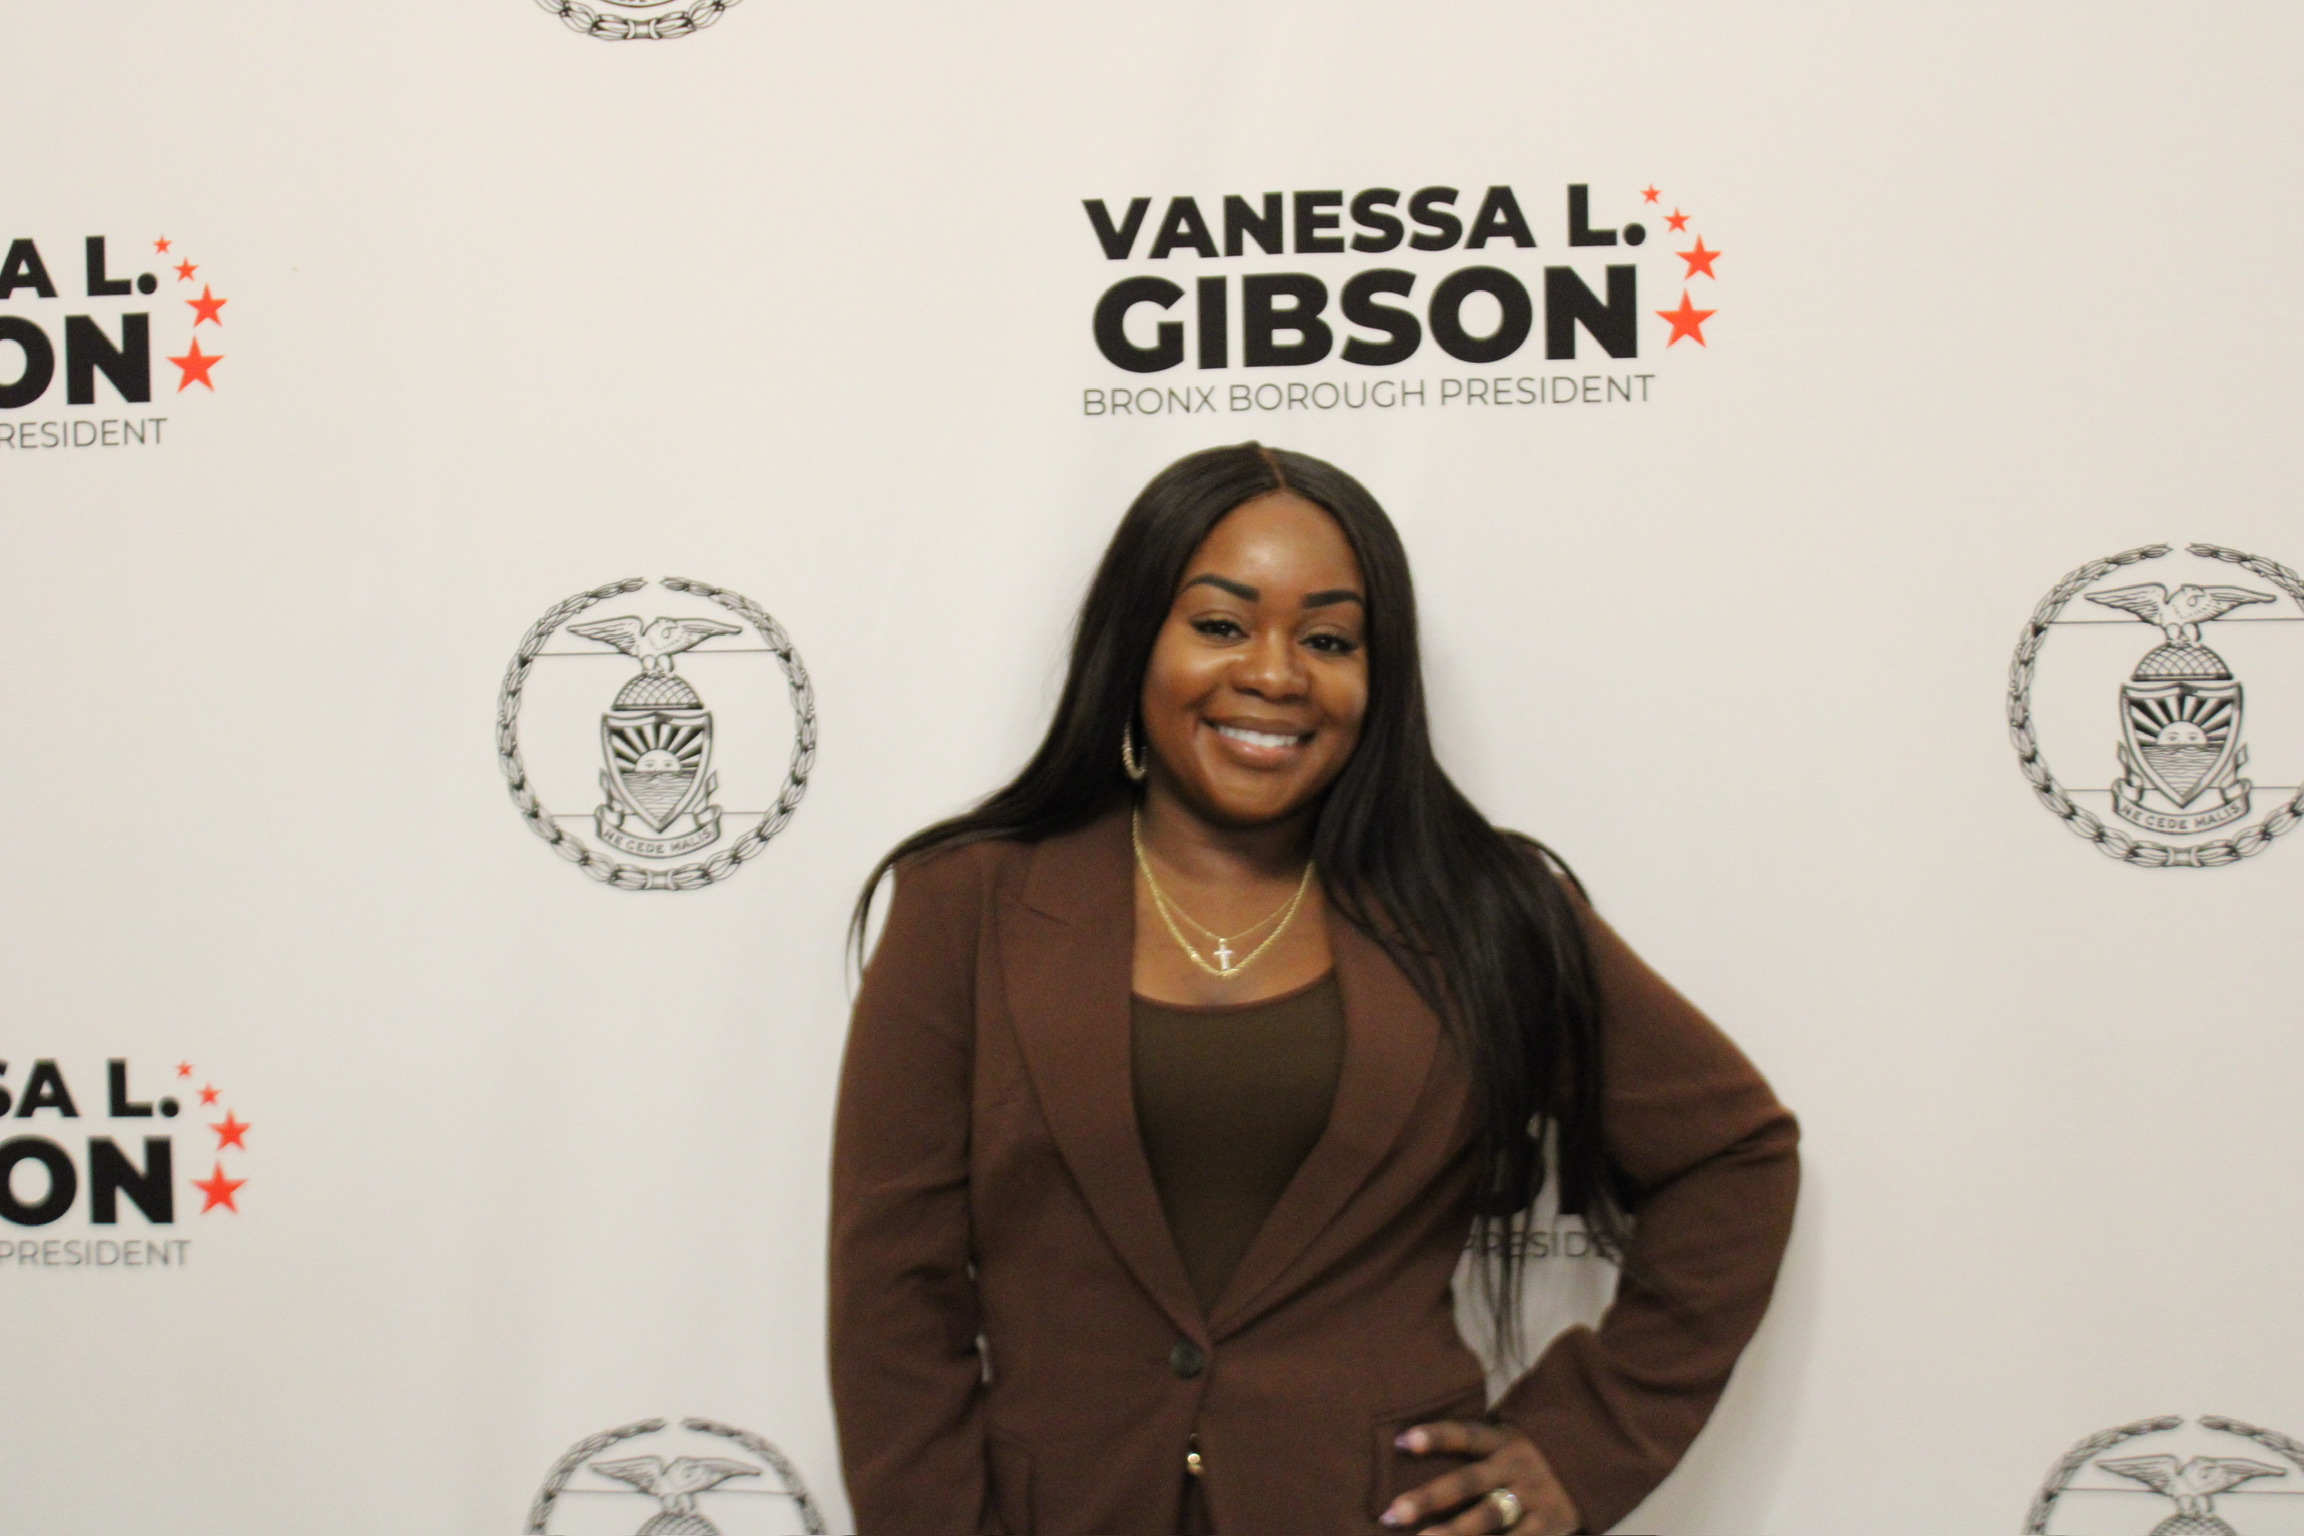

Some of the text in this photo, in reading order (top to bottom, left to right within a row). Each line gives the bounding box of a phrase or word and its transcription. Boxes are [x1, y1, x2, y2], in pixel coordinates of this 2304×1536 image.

[1082, 184, 1647, 260] VANESSA L.
[85, 235, 158, 297] L.
[1092, 264, 1638, 374] GIBSON
[1083, 373, 1656, 416] BRONX BOROUGH PRESIDENT
[0, 1058, 180, 1118] A L.
